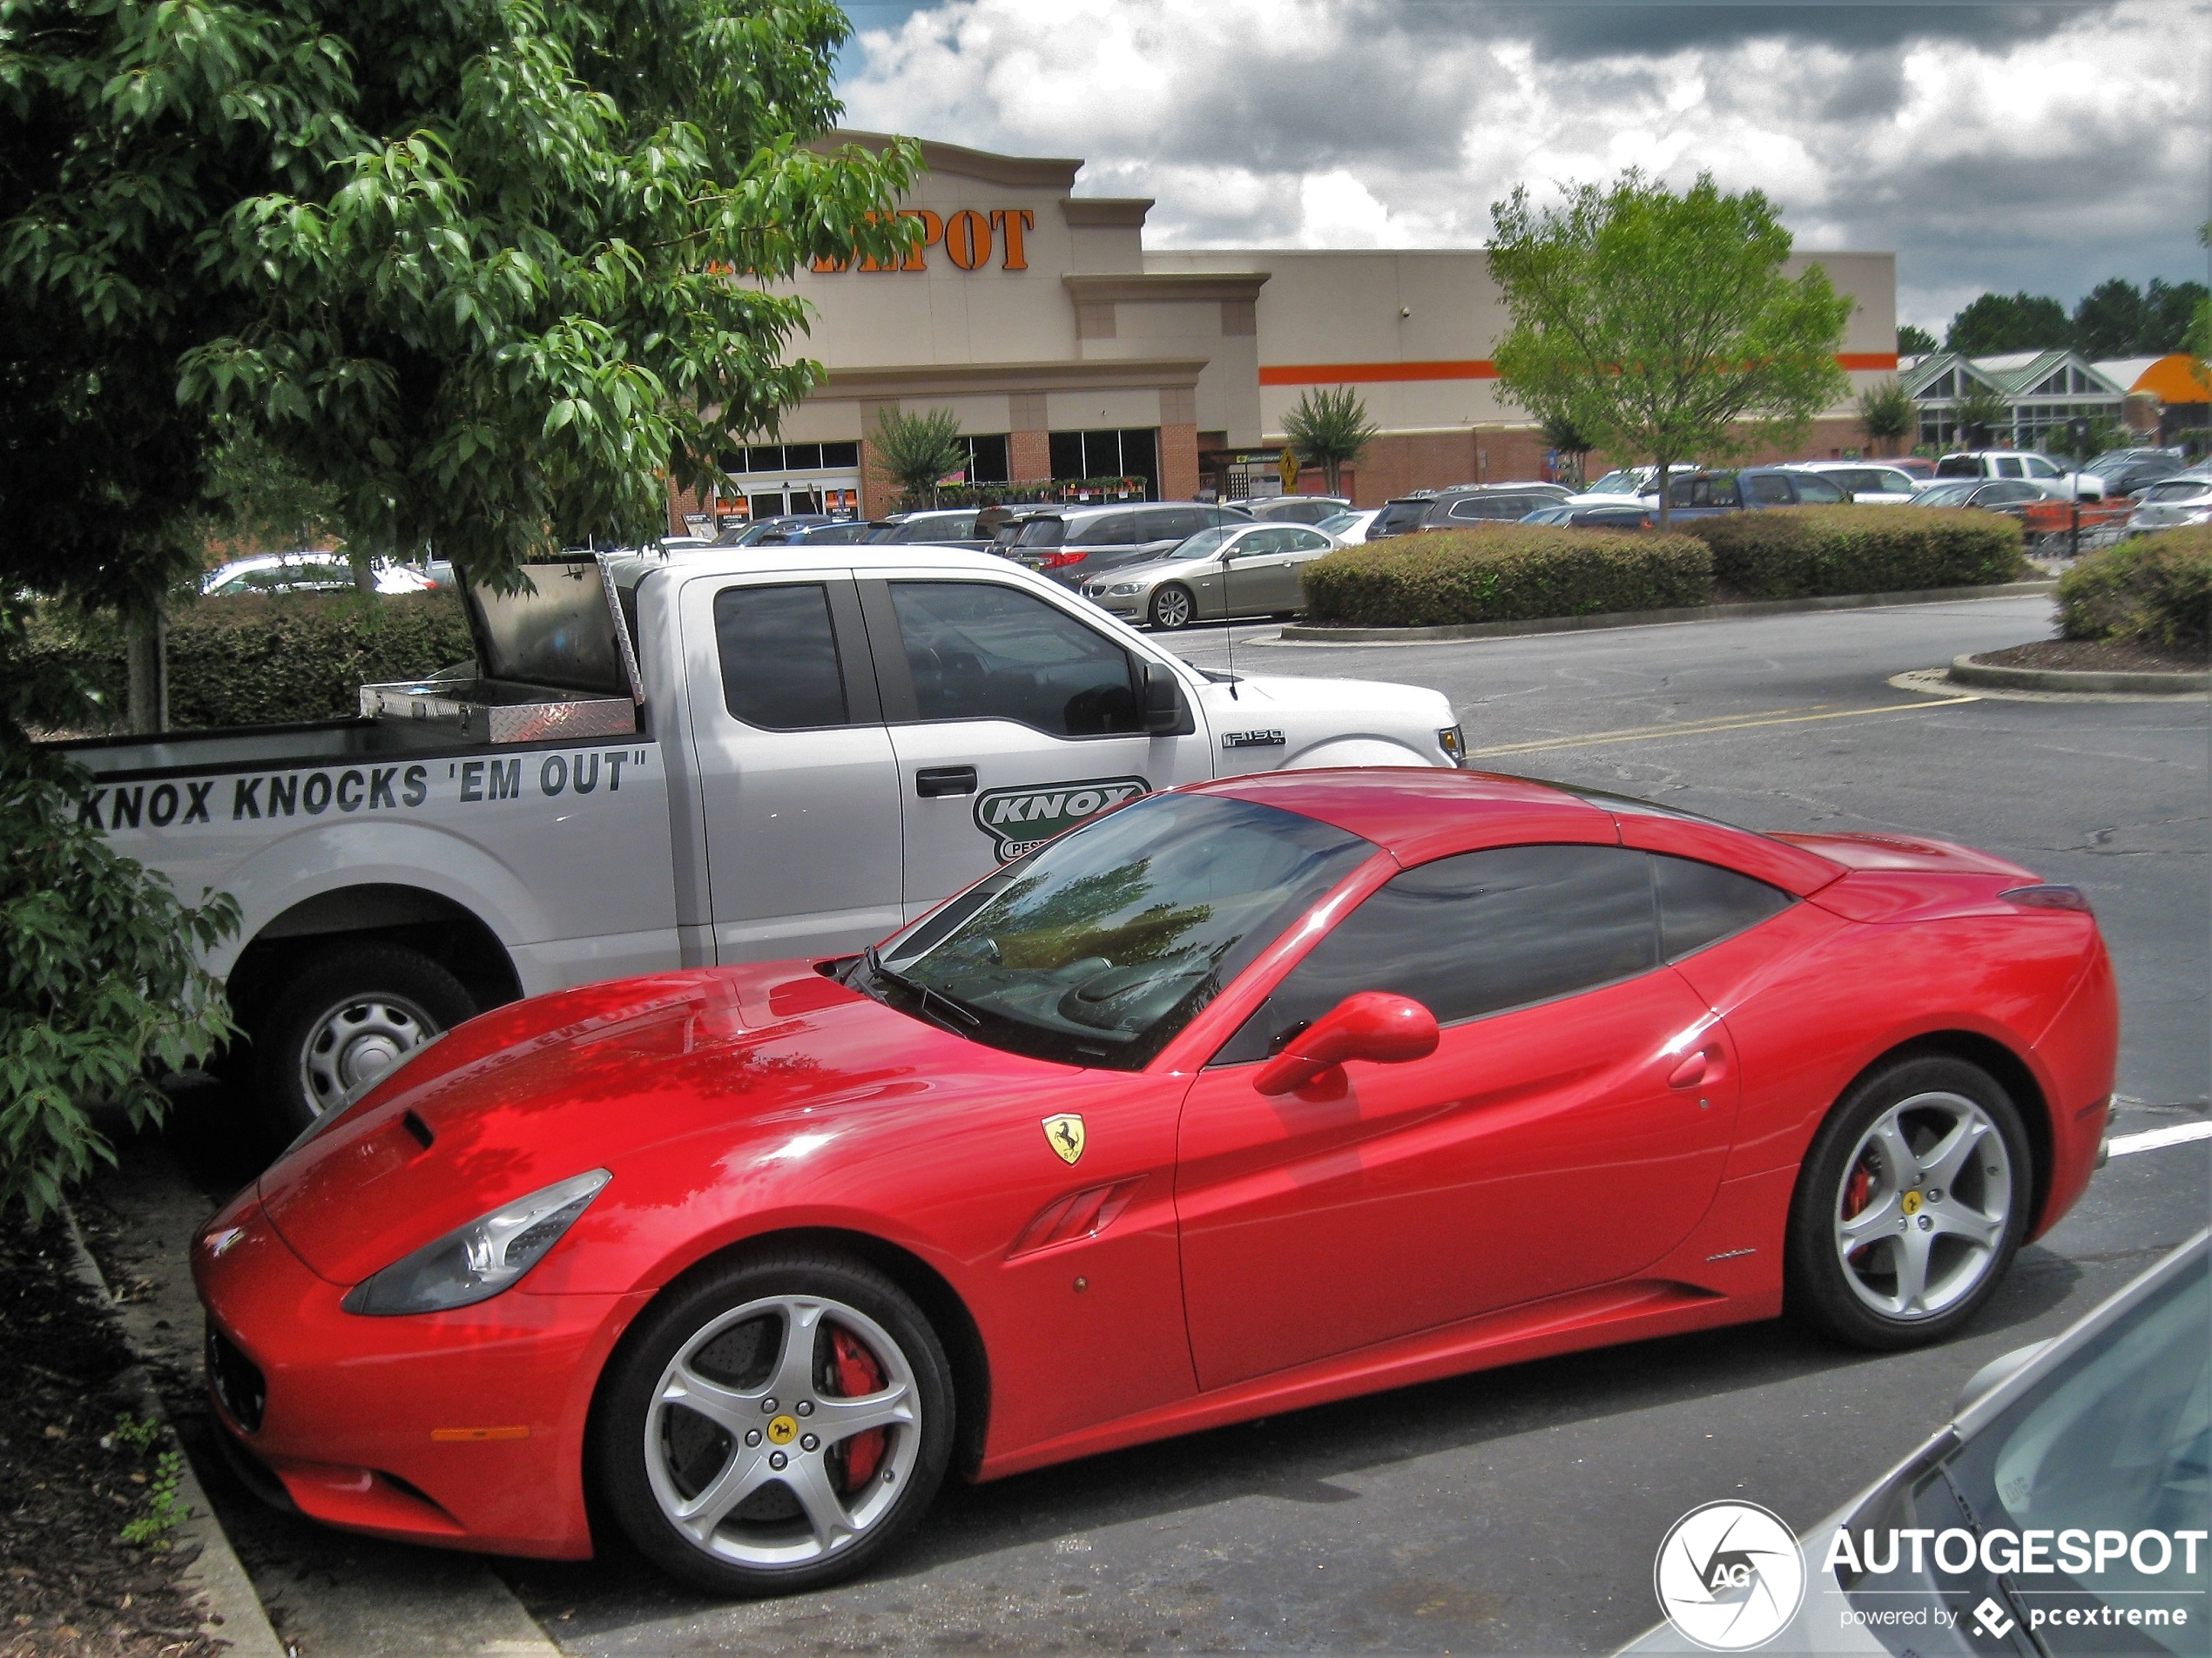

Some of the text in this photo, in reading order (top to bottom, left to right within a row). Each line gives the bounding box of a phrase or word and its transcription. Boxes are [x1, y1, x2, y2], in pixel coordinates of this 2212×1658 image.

[232, 764, 427, 820] KNOCKS
[448, 758, 522, 803] 'EM
[539, 749, 647, 797] OUT"
[991, 787, 1136, 825] KNOX
[1012, 840, 1046, 855] PES
